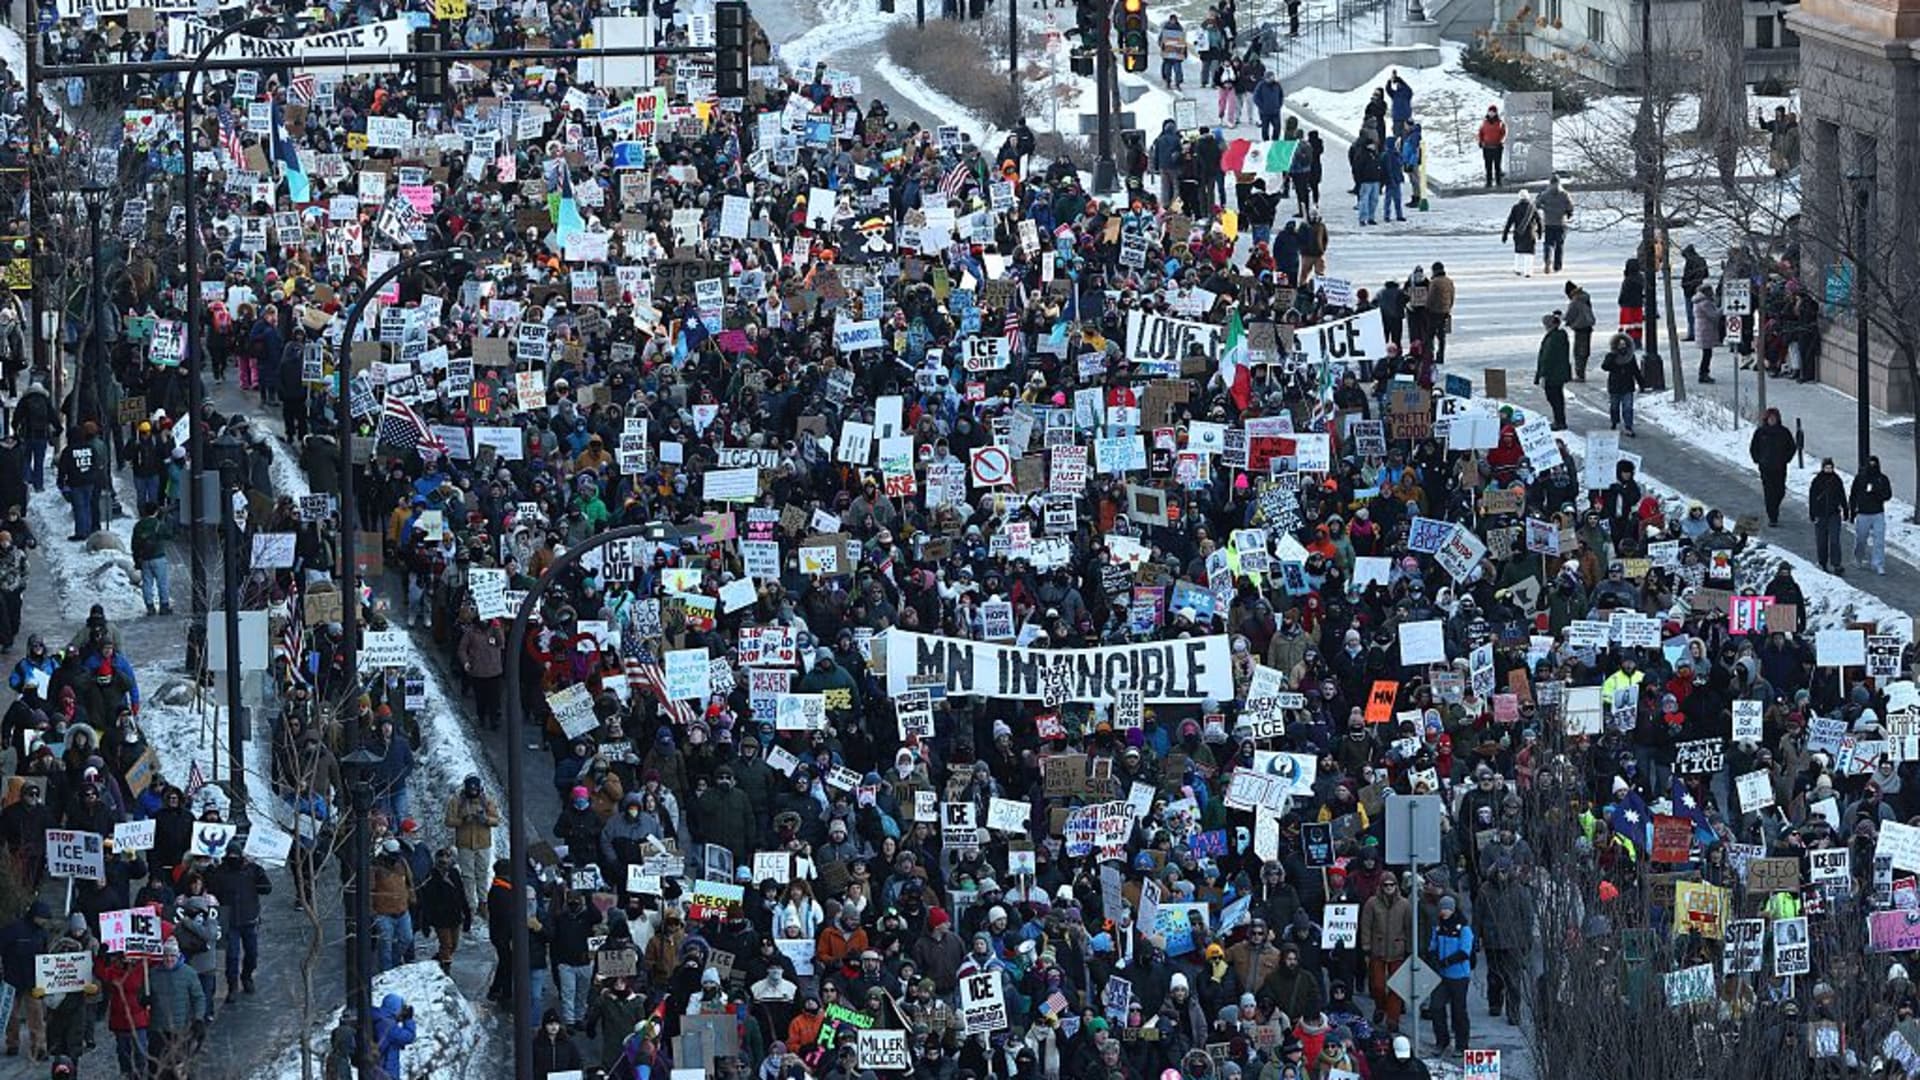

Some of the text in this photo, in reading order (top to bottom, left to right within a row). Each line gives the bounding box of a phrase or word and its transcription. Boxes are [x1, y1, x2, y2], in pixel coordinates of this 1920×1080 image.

[240, 33, 295, 57] MANY
[1134, 315, 1200, 359] LOVE
[1317, 318, 1366, 359] ICE
[969, 339, 998, 357] ICE
[472, 382, 491, 399] ICE
[473, 398, 493, 415] OUT
[721, 449, 778, 467] ICE OUT
[1056, 472, 1082, 481] JUST
[601, 541, 630, 561] ICE
[602, 562, 632, 580] OUT
[376, 633, 395, 642] ICE
[1869, 646, 1901, 657] ICE
[917, 636, 1209, 700] MN INVINCIBLE
[753, 672, 786, 682] NEVER
[898, 701, 929, 713] ICE
[1252, 719, 1283, 737] ICE
[947, 804, 969, 825] ICE
[48, 832, 76, 843] STOP
[57, 844, 83, 860] ICE
[54, 862, 97, 876] TERROR
[759, 855, 785, 869] ICE
[1751, 860, 1797, 878] GTFO
[755, 870, 786, 883] OUT
[693, 894, 713, 906] ICE
[130, 914, 155, 937] ICE
[1726, 923, 1763, 943] STOP
[710, 950, 732, 966] ICE
[968, 975, 995, 1002] ICE
[860, 1035, 905, 1052] MILLER
[861, 1053, 906, 1067] KILLER
[1465, 1051, 1497, 1064] HOT
[1466, 1064, 1499, 1074] PEOPLE
